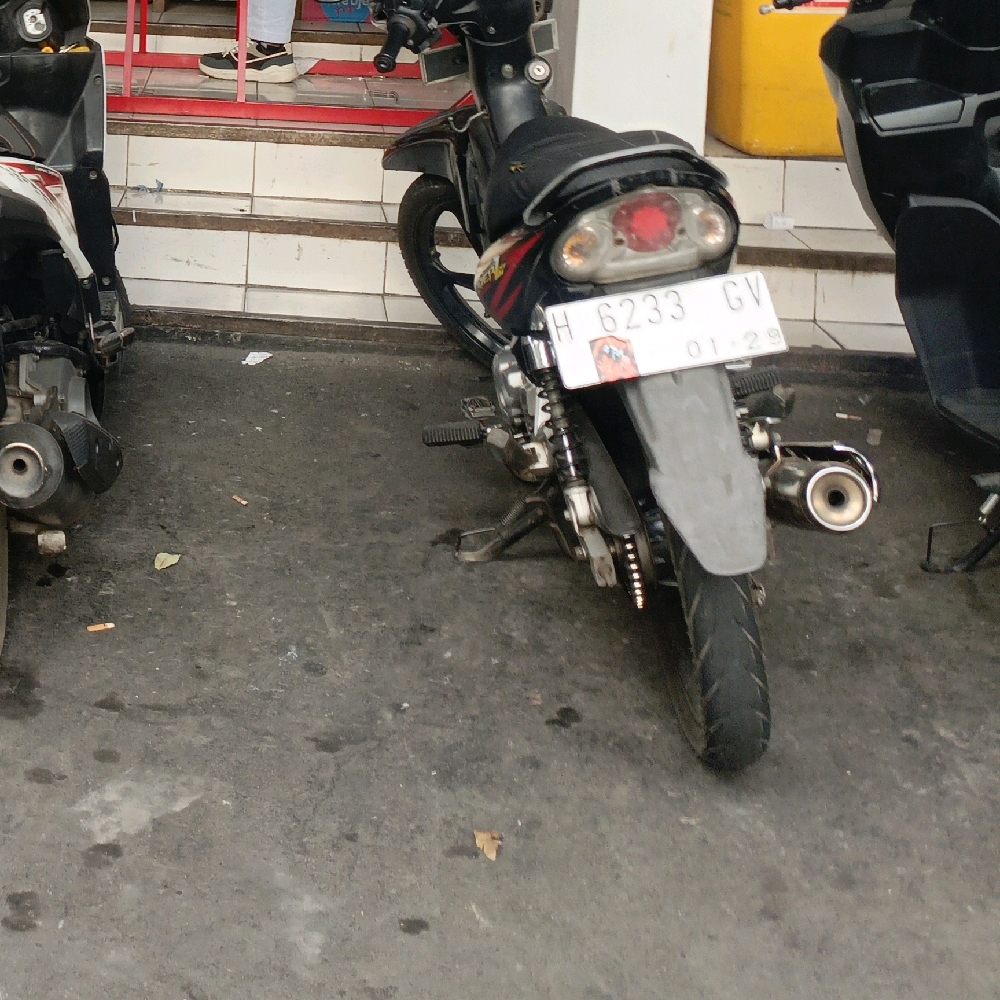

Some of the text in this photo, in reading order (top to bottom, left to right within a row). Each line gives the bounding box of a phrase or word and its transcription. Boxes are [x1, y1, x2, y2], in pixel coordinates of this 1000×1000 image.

[551, 276, 762, 343] H 6233 GV
